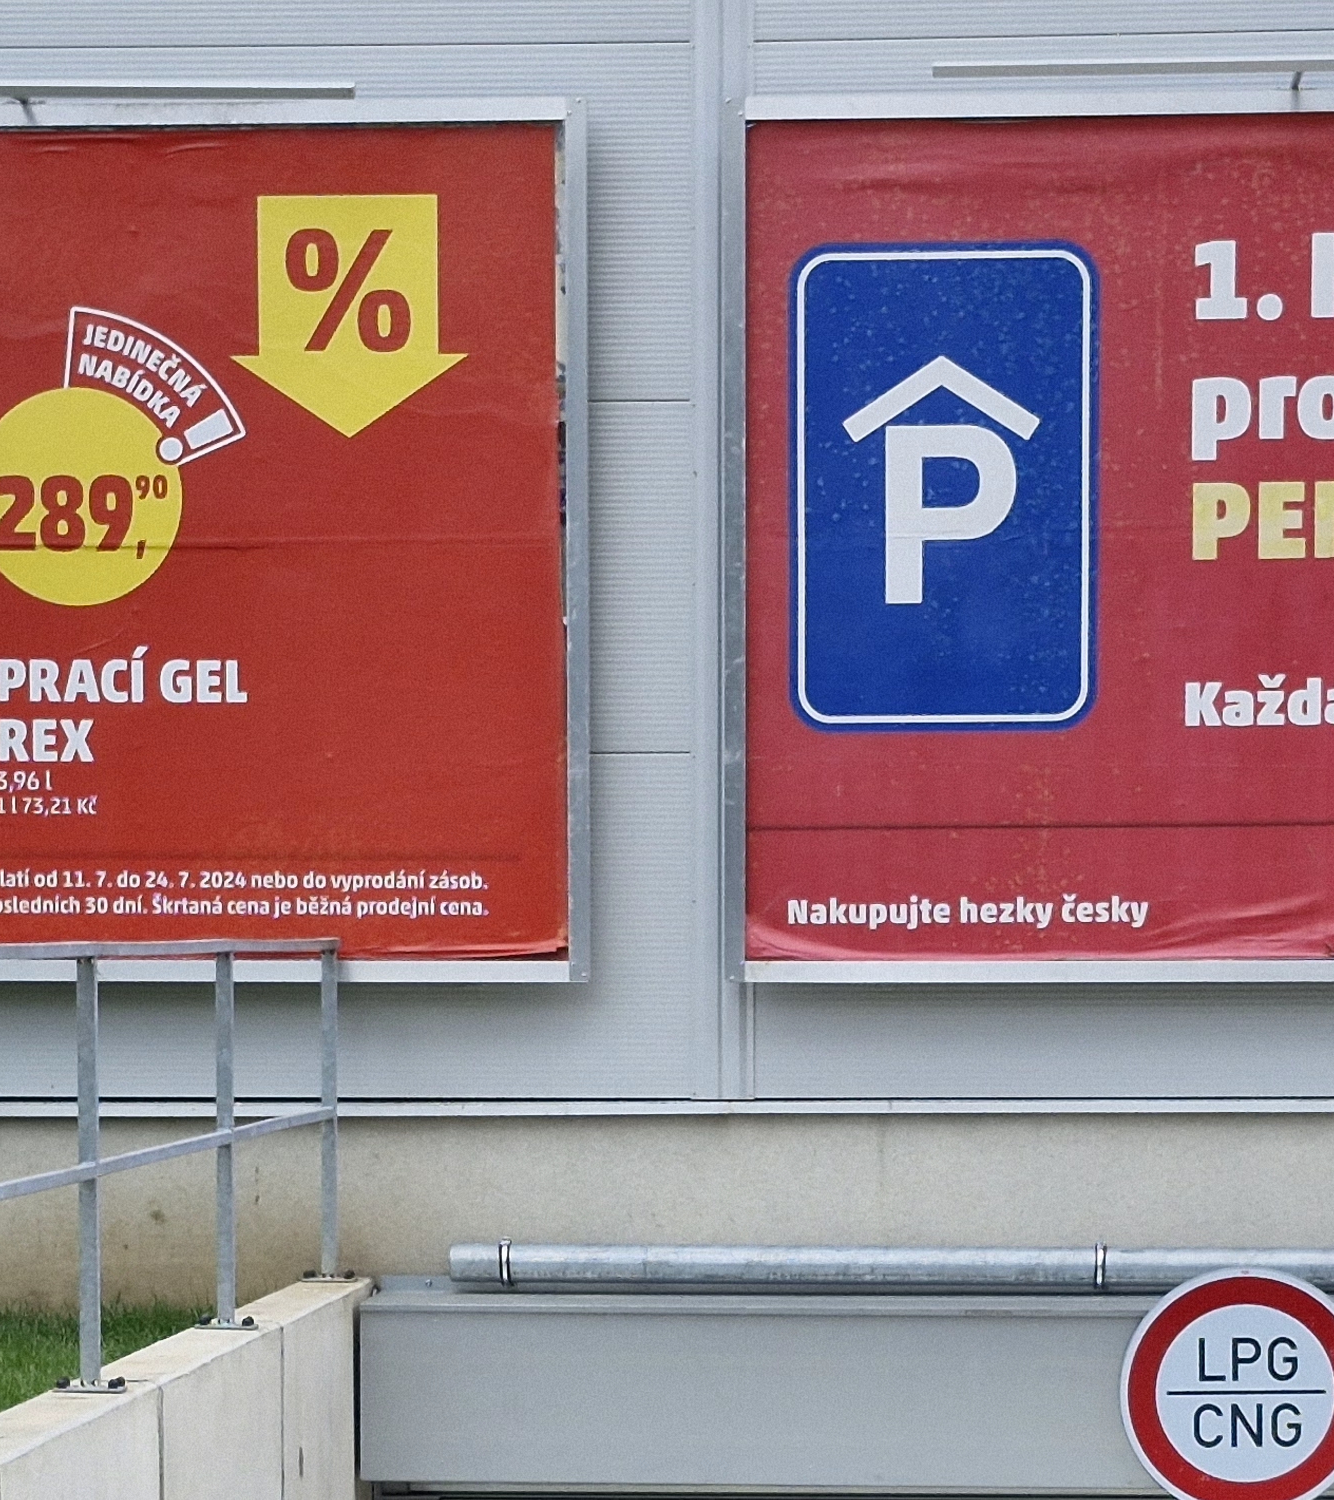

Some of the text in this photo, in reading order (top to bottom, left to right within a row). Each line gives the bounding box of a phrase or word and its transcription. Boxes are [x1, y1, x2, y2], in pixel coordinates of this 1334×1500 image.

[1194, 240, 1283, 320] 1.
[83, 323, 208, 408] JEDINEČNÁ
[885, 424, 1017, 604] P
[159, 659, 248, 704] GEL
[22, 797, 72, 817] 73,21
[77, 795, 98, 815] Kč
[34, 870, 58, 888] od
[62, 871, 92, 888] 11.
[95, 871, 113, 888] 7.
[117, 870, 140, 888] do
[145, 871, 175, 888] 24.
[178, 871, 196, 888] 7.
[199, 870, 247, 888] 2024
[251, 870, 298, 888] nebo
[302, 870, 327, 888] do
[330, 869, 425, 892] vyprodání
[429, 869, 489, 890] zásob.
[85, 896, 109, 914] 30
[112, 895, 147, 914] dní.
[152, 892, 222, 916] Škrtaná
[226, 899, 269, 916] cena
[273, 897, 292, 919] je
[296, 895, 352, 916] běžná
[356, 897, 435, 919] prodejní
[787, 893, 1149, 930] Nakupujte hezky česky
[1198, 1336, 1299, 1383] LPG
[1193, 1402, 1302, 1449] CNG
